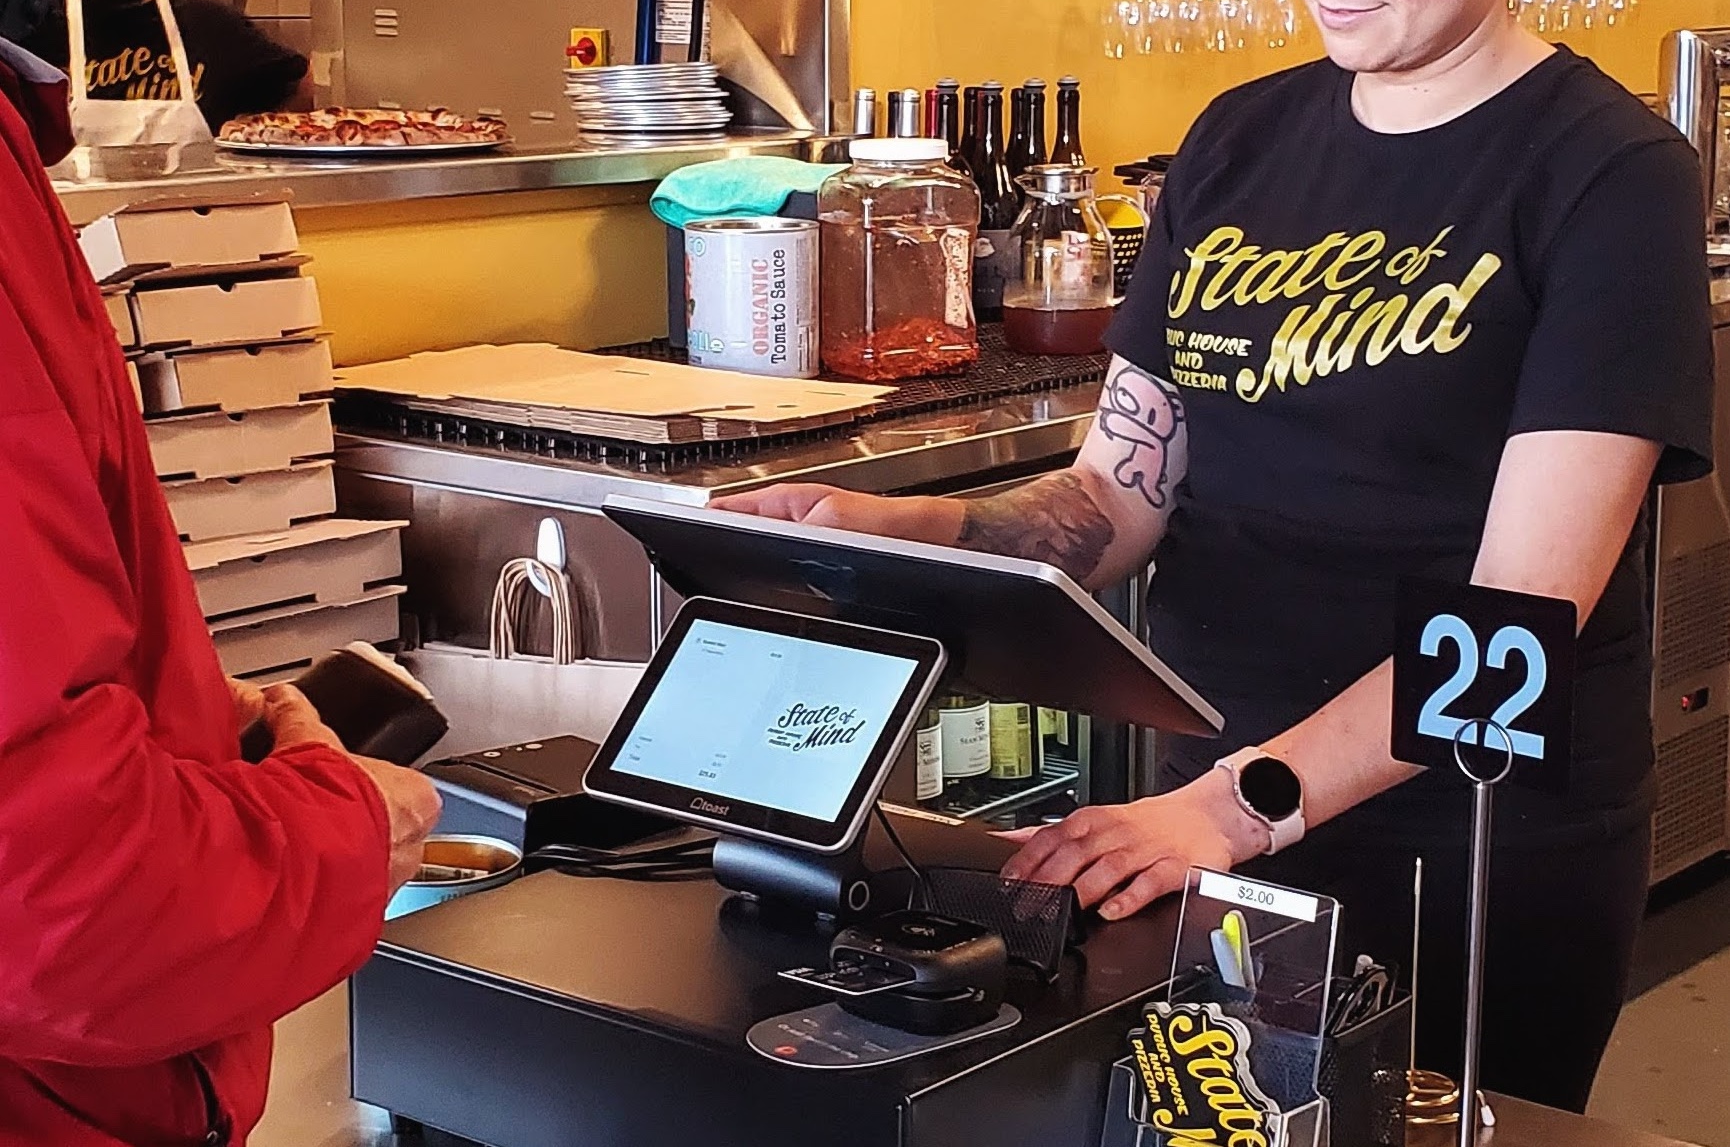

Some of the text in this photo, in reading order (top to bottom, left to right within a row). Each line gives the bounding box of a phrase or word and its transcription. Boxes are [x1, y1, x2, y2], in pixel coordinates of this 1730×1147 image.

[85, 46, 154, 92] tate
[1167, 224, 1455, 319] State of
[752, 259, 769, 356] ORGANIC
[770, 249, 787, 365] Tomato Sauce
[1235, 252, 1502, 403] Mind
[1175, 350, 1203, 370] AND
[1188, 331, 1253, 357] HOUSE
[1417, 614, 1547, 760] 22
[778, 703, 857, 728] State of
[793, 720, 866, 751] Mind
[702, 799, 730, 815] toast
[1237, 885, 1275, 906] $2.00
[1132, 1039, 1161, 1103] PIZZERIA
[1146, 1013, 1189, 1116] PUBLIC HOUSE
[1148, 1052, 1165, 1083] AND
[1169, 1014, 1267, 1147] State
